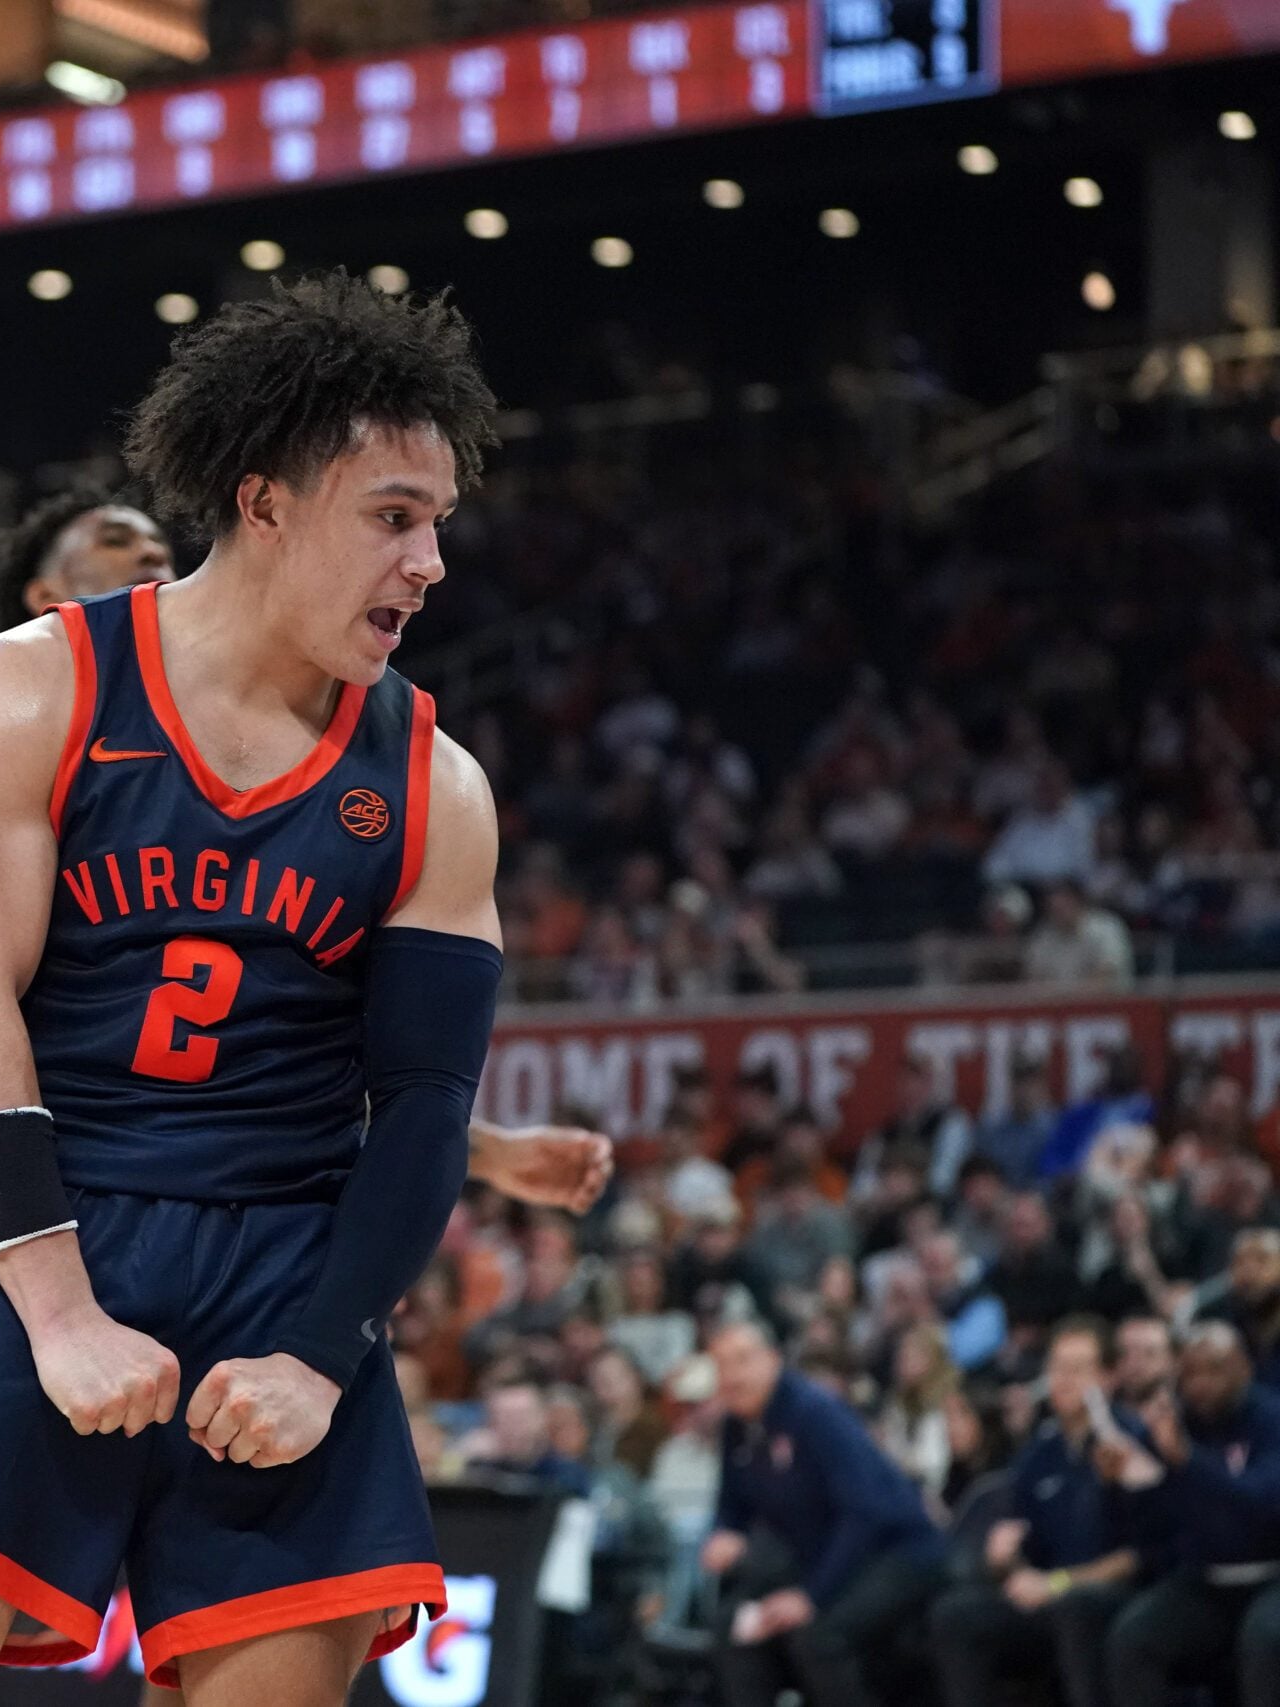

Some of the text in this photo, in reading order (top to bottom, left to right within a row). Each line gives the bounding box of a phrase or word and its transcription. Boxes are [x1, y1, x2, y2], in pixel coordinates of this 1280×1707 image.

[62, 846, 365, 970] VIRGINIA
[130, 934, 244, 1083] 2
[473, 1035, 708, 1142] OME
